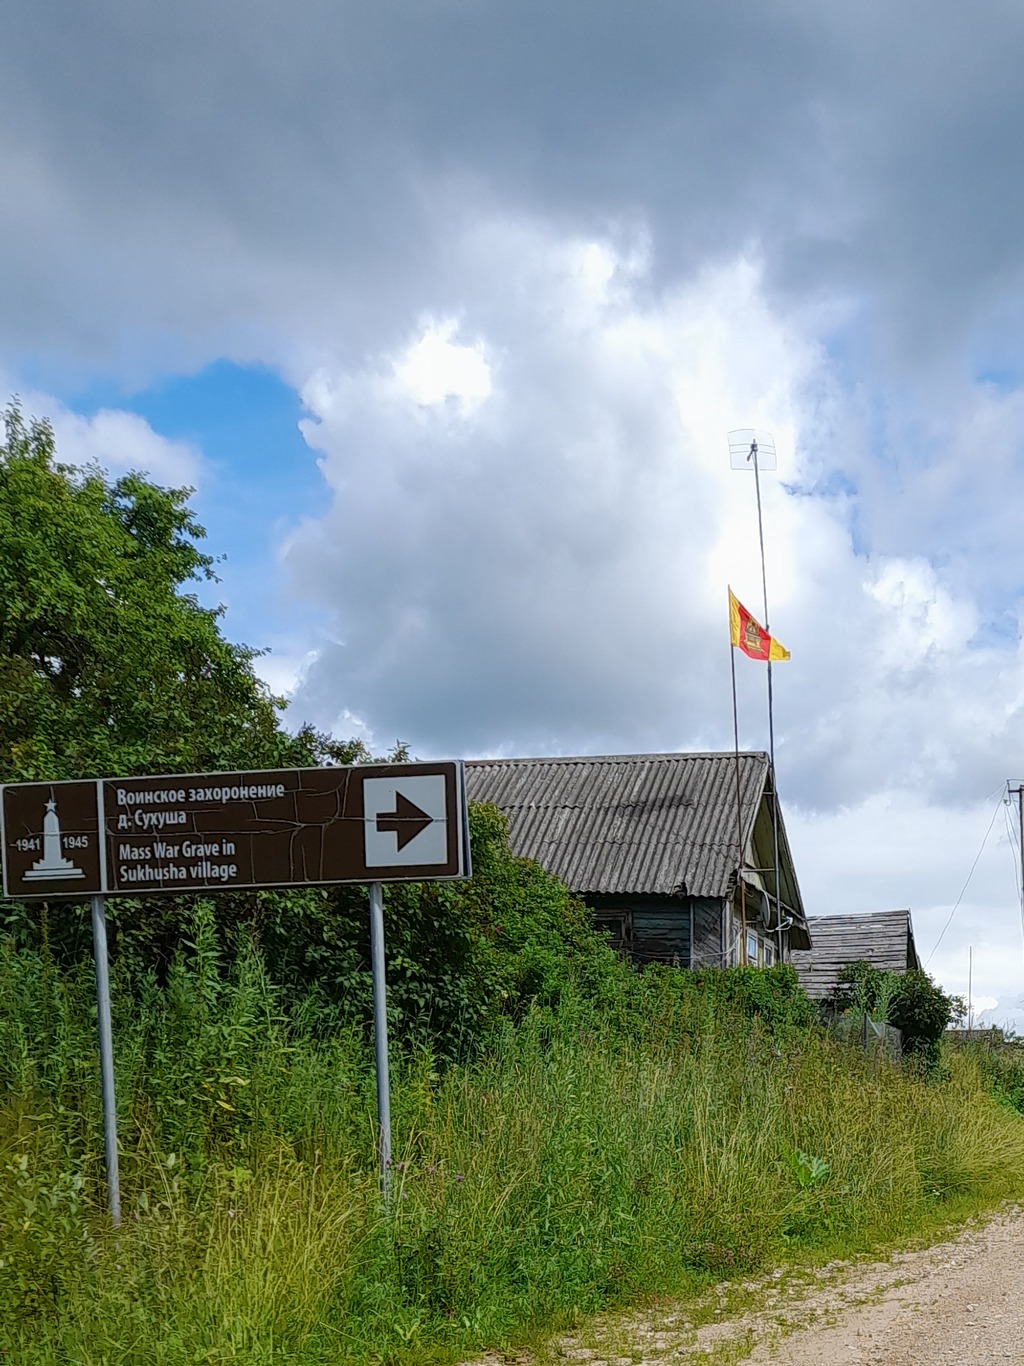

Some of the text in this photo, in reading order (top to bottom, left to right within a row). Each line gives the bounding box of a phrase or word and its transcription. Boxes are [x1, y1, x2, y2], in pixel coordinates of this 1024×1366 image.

[117, 784, 285, 805] Воинское захоронение
[117, 810, 187, 830] д. Сухуша
[16, 838, 41, 852] 1941
[62, 836, 89, 850] 1945
[119, 838, 236, 861] Mass War Grave in
[119, 861, 238, 882] Sukhusha village
